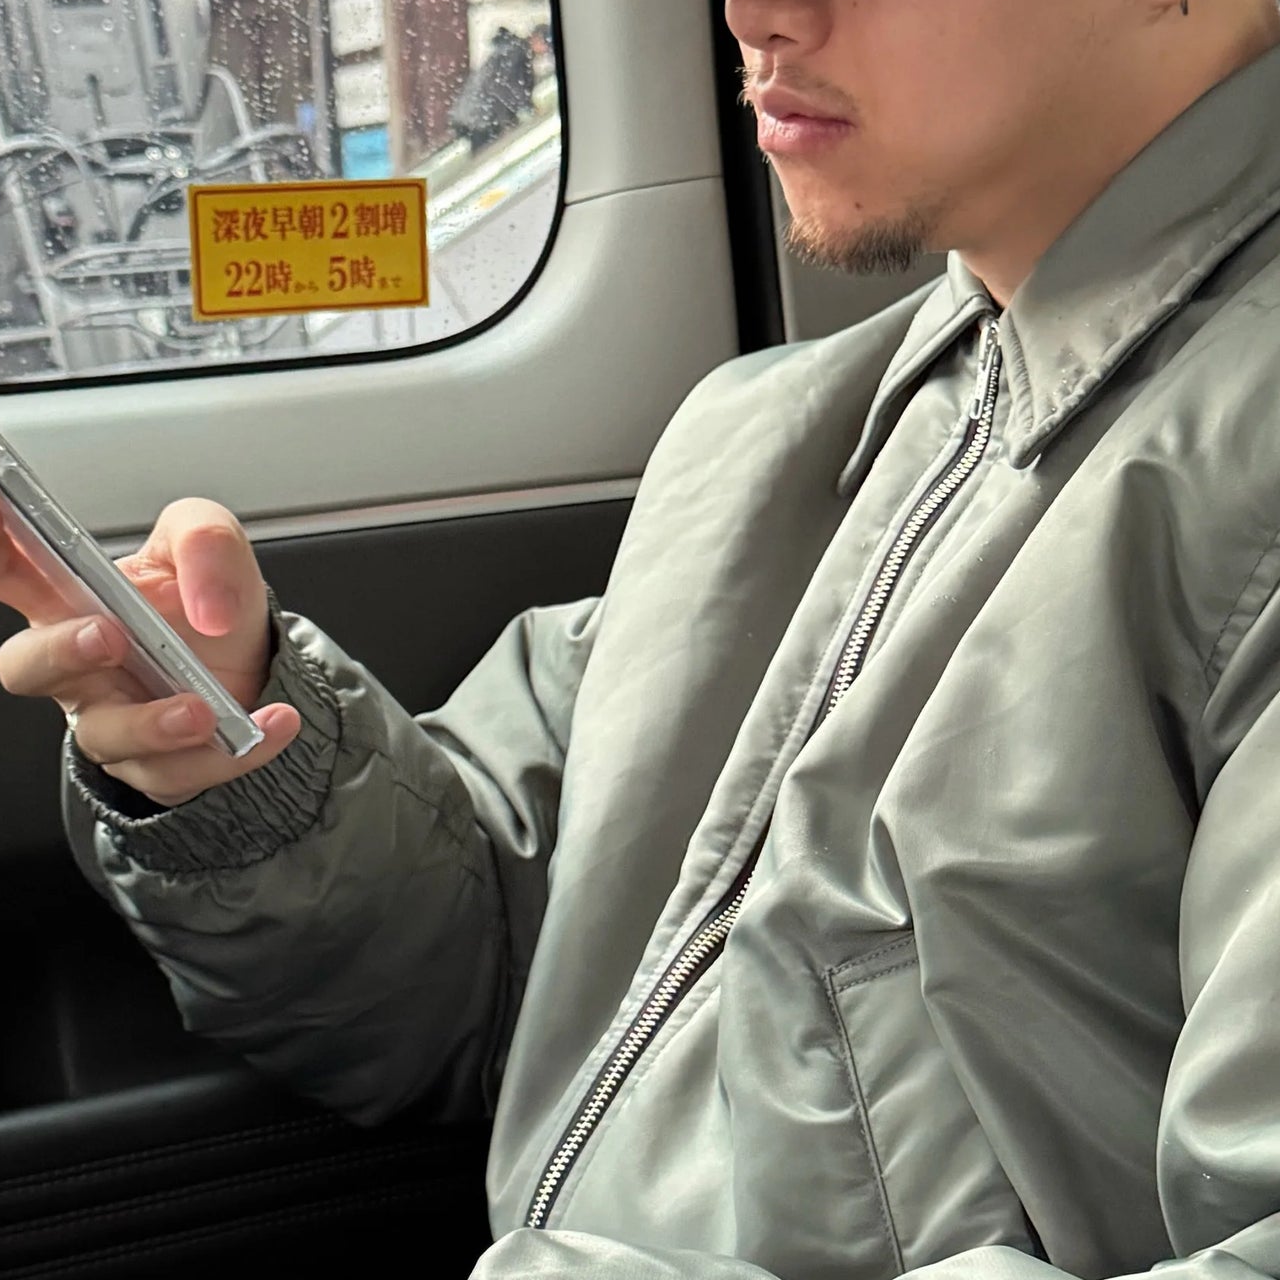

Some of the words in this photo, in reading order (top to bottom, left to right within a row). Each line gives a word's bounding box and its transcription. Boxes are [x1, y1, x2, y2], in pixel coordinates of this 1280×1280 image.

[212, 201, 407, 243] 深夜早朝2割増
